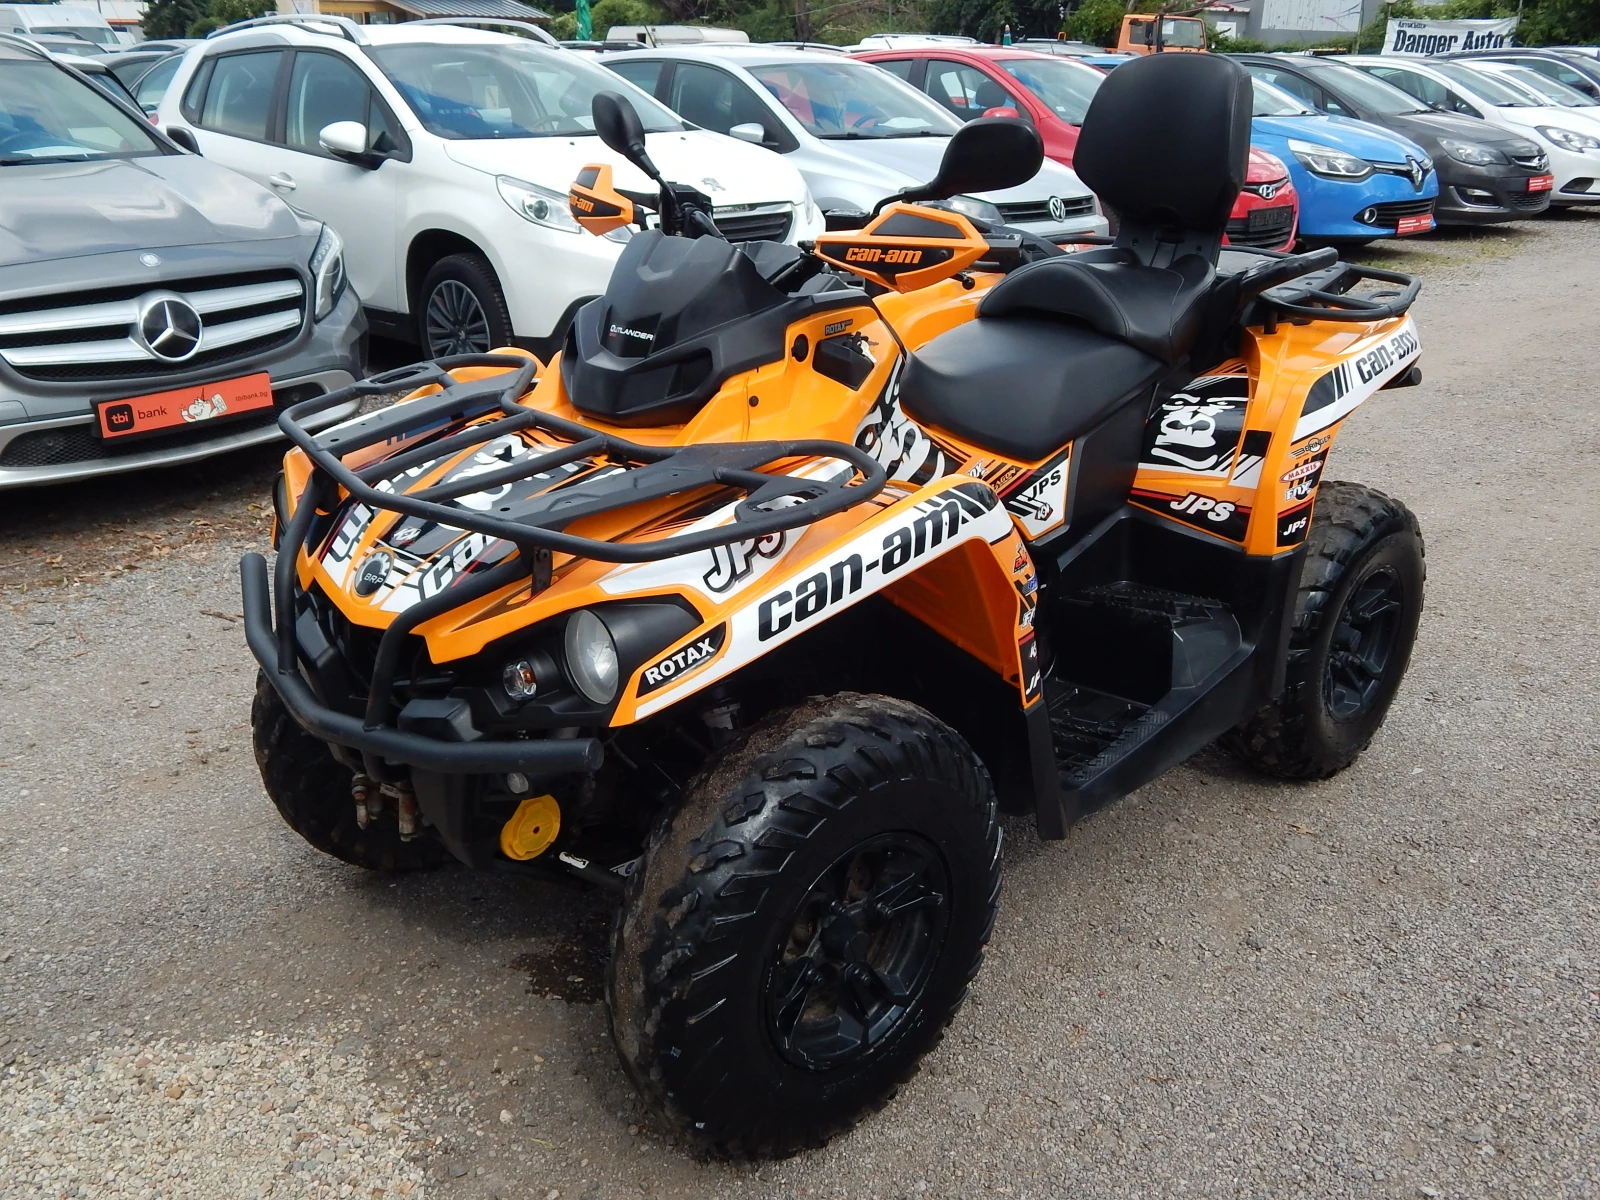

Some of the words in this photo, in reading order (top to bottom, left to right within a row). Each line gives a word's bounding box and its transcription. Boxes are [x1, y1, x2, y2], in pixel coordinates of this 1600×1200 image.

[1393, 29, 1459, 57] Danger
[1461, 31, 1505, 51] Auto
[845, 247, 922, 264] can-am
[825, 322, 846, 335] ROTAX
[1355, 330, 1418, 385] can-am
[235, 390, 268, 402] tbibank.bg
[111, 411, 129, 424] tbi
[137, 406, 168, 420] bank
[1288, 463, 1317, 480] MAXXIS
[1027, 469, 1061, 502] JPS
[1285, 480, 1313, 501] FOX
[1170, 494, 1236, 522] JPS
[1283, 517, 1307, 536] JPS
[363, 572, 384, 584] BRP
[758, 499, 960, 642] can-am
[644, 637, 716, 685] ROTAX
